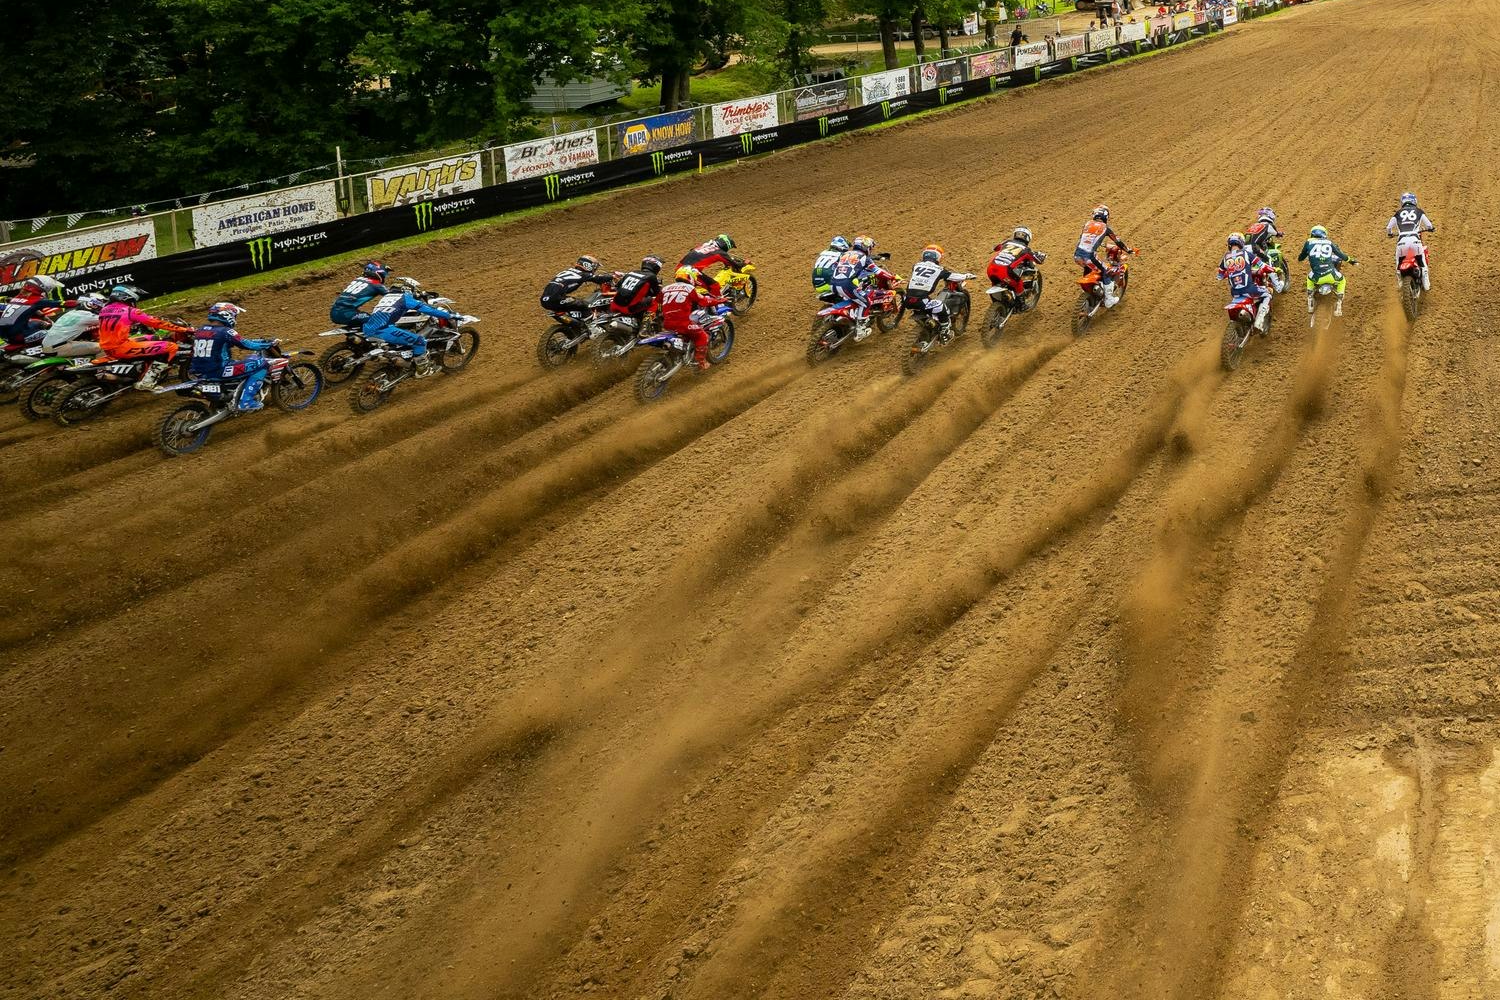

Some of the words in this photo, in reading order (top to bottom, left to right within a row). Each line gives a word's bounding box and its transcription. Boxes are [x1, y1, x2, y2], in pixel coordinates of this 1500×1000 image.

[722, 102, 770, 120] Trimble's
[828, 115, 849, 125] MONSTER
[627, 131, 647, 147] NAPA
[752, 131, 778, 142] MONSTER
[521, 161, 555, 174] HONDA
[567, 150, 595, 162] YAMAHA
[664, 150, 692, 161] MONSTER
[371, 159, 477, 207] VAITH'S
[560, 171, 595, 184] MONSTER
[434, 197, 476, 213] MONSTER
[218, 207, 281, 231] AMERICAN
[283, 201, 316, 217] HOME
[268, 220, 285, 228] Patio
[290, 215, 304, 224] Spas
[1400, 209, 1416, 222] 96
[274, 231, 328, 249] MONSTER
[1309, 243, 1333, 258] 49
[1225, 255, 1246, 272] 29
[914, 266, 936, 279] 42
[66, 273, 135, 296] MONSTER
[390, 329, 417, 343] UFO
